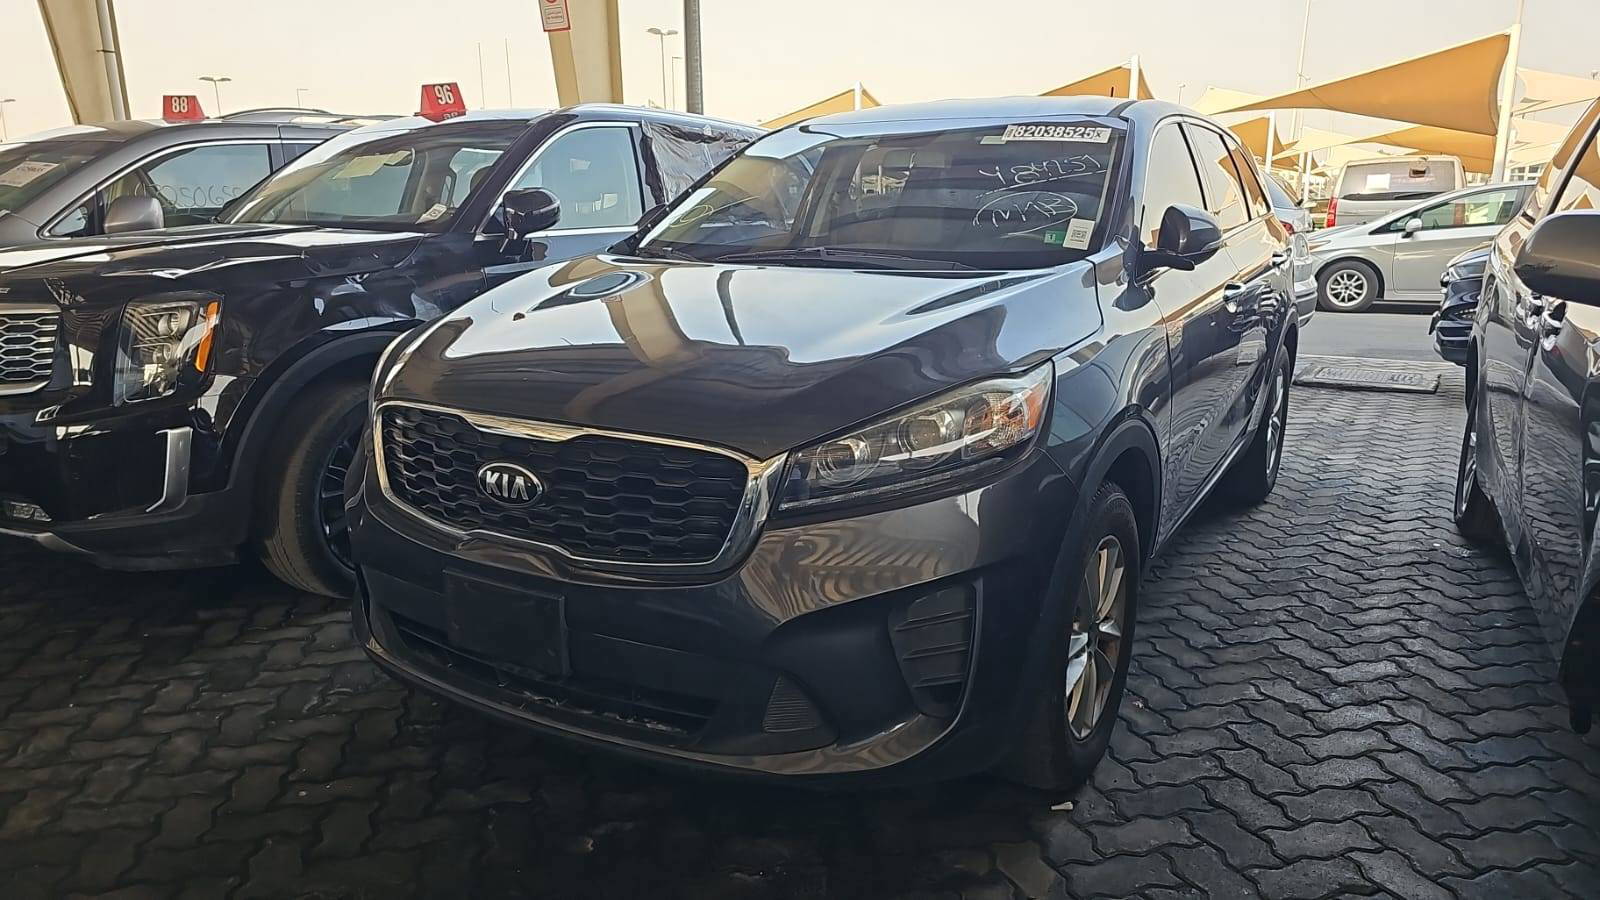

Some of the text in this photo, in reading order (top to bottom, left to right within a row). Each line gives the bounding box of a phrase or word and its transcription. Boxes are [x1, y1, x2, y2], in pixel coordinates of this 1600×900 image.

[171, 96, 188, 113] 88
[434, 84, 455, 105] 96
[486, 470, 529, 501] KIA
